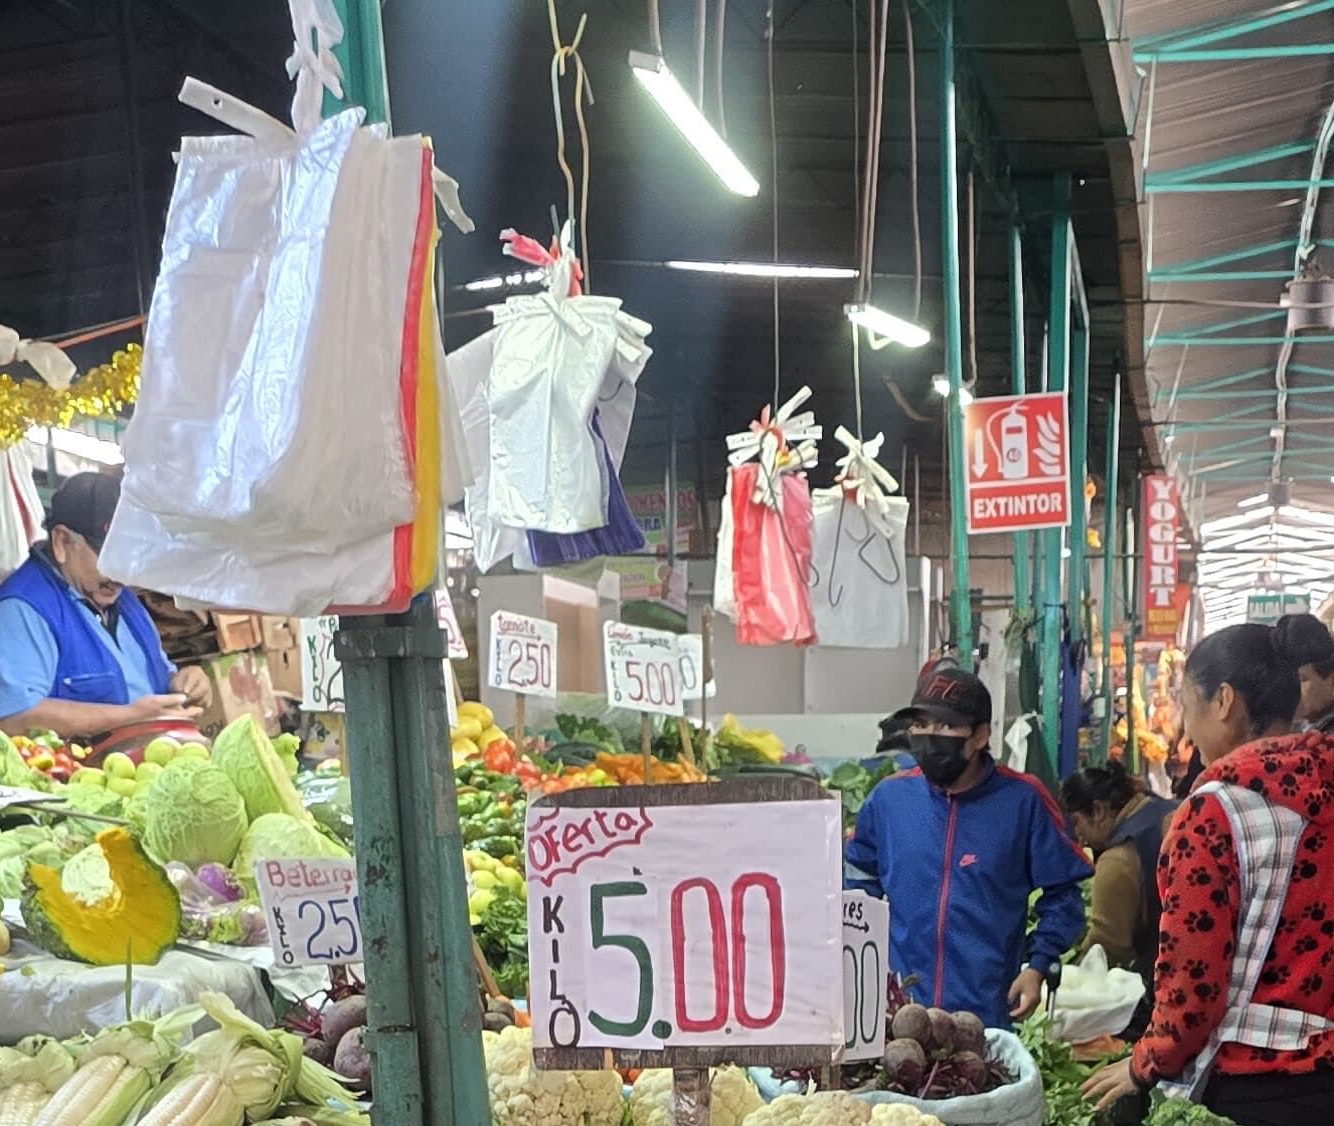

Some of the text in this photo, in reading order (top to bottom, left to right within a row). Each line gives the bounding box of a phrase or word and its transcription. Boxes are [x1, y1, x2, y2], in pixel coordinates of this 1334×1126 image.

[973, 493, 1062, 519] EXTINTOR
[1149, 479, 1177, 607] YOGURT
[625, 661, 676, 706] 5.00
[266, 860, 356, 889] Beterra
[298, 895, 361, 960] 2.5
[542, 871, 787, 1049] KILO 5.00
